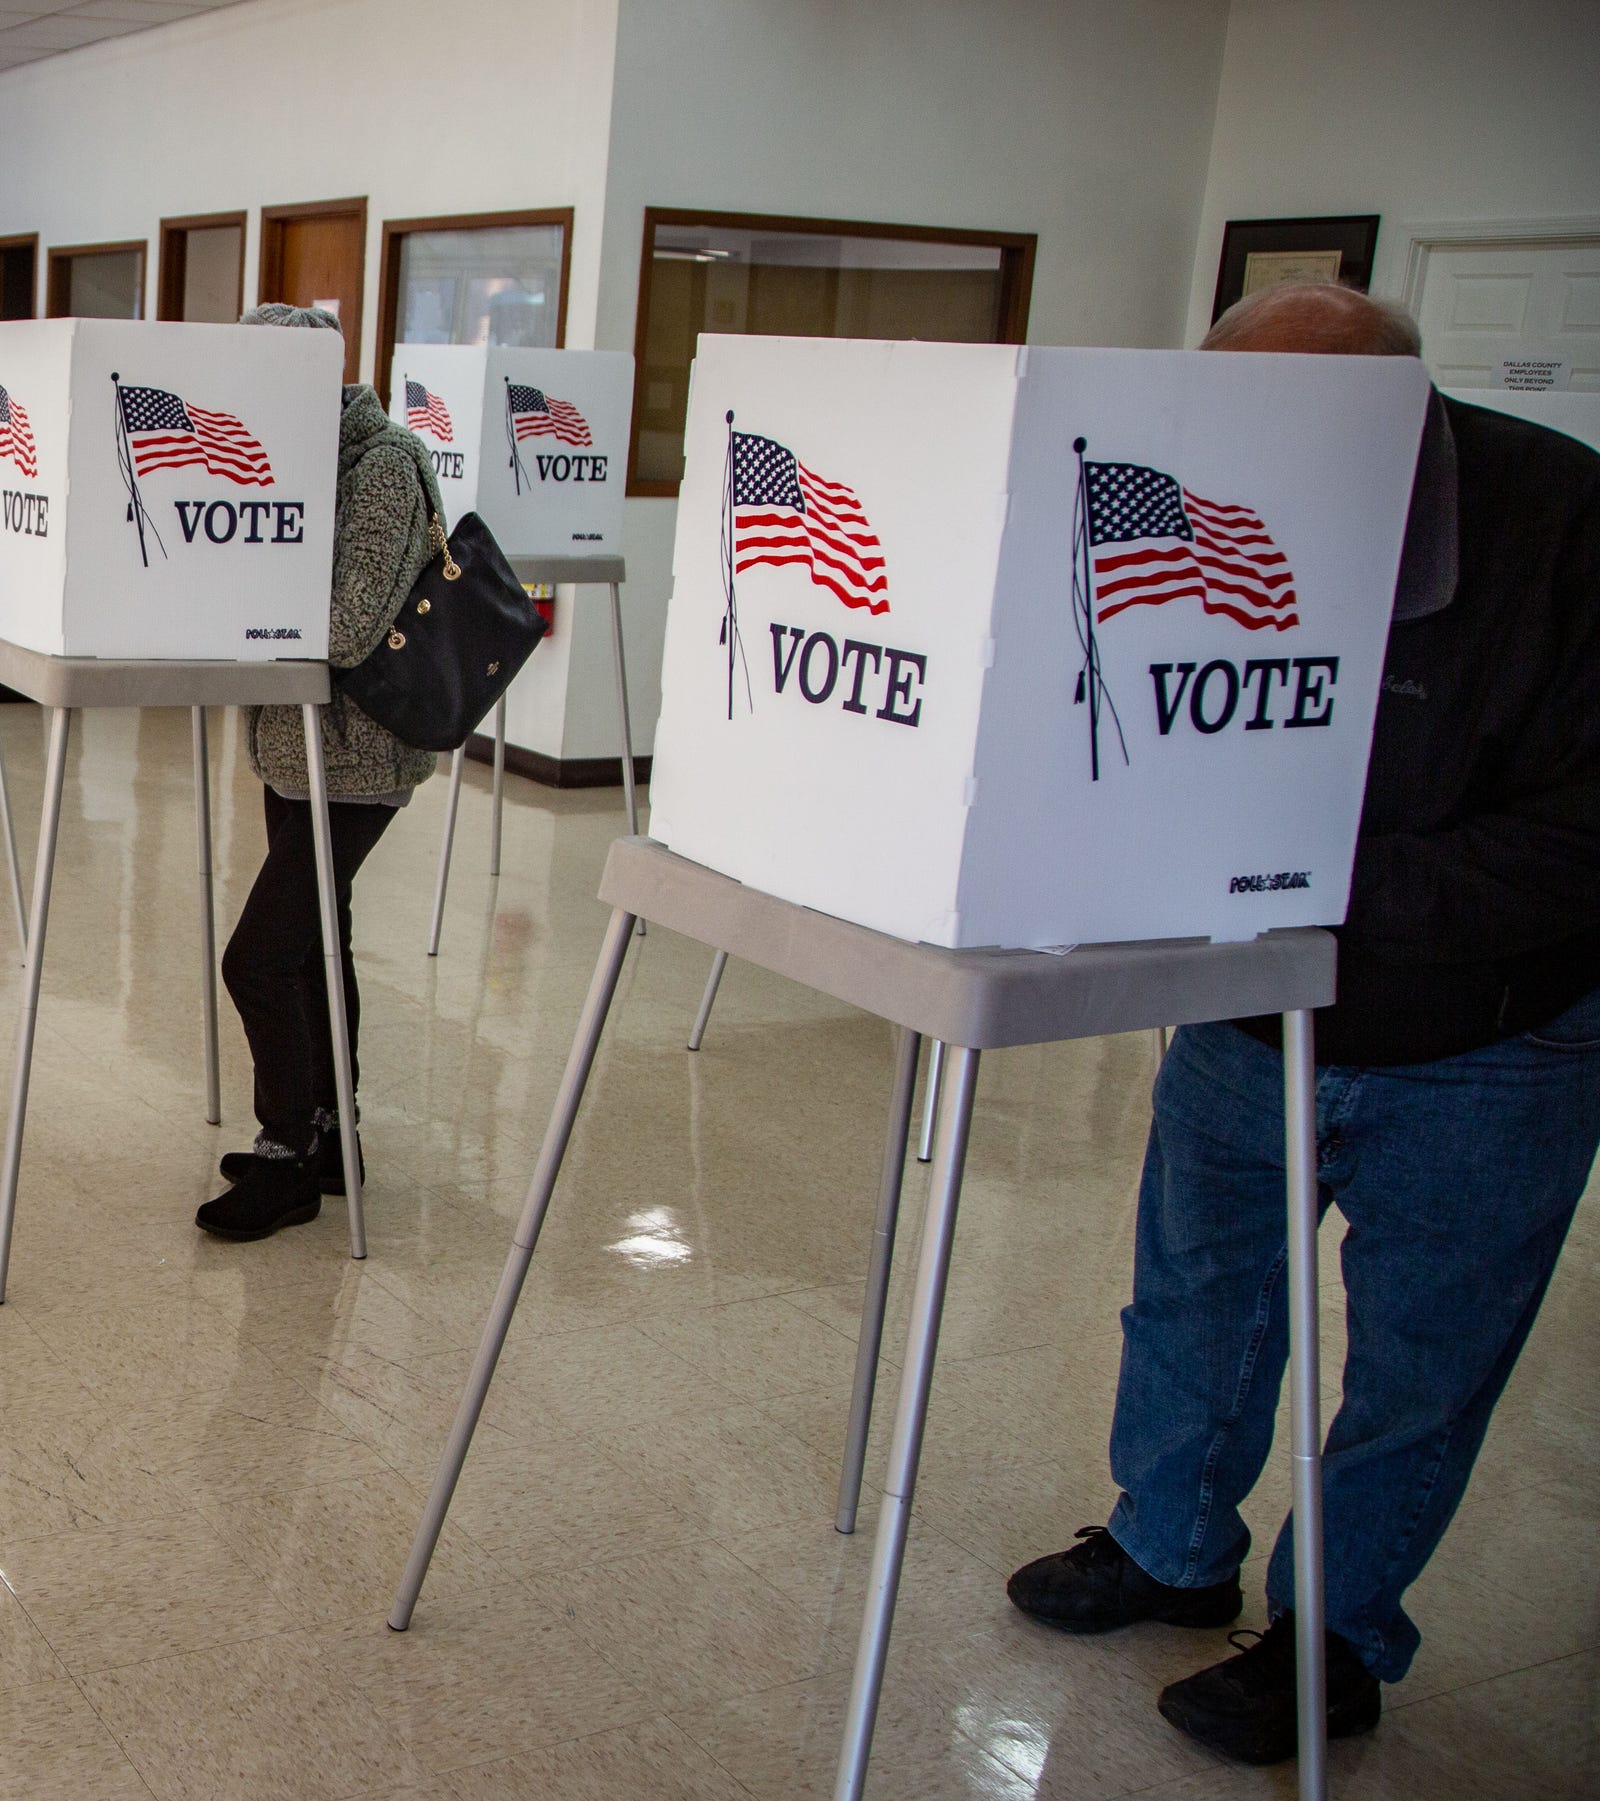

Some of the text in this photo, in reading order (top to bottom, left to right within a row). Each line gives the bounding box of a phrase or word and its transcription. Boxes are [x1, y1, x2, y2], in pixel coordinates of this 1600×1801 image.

[536, 455, 608, 482] VOTE
[3, 489, 49, 538] VOTE
[174, 501, 304, 544] VOTE
[769, 622, 928, 728] VOTE
[1149, 656, 1340, 736] VOTE
